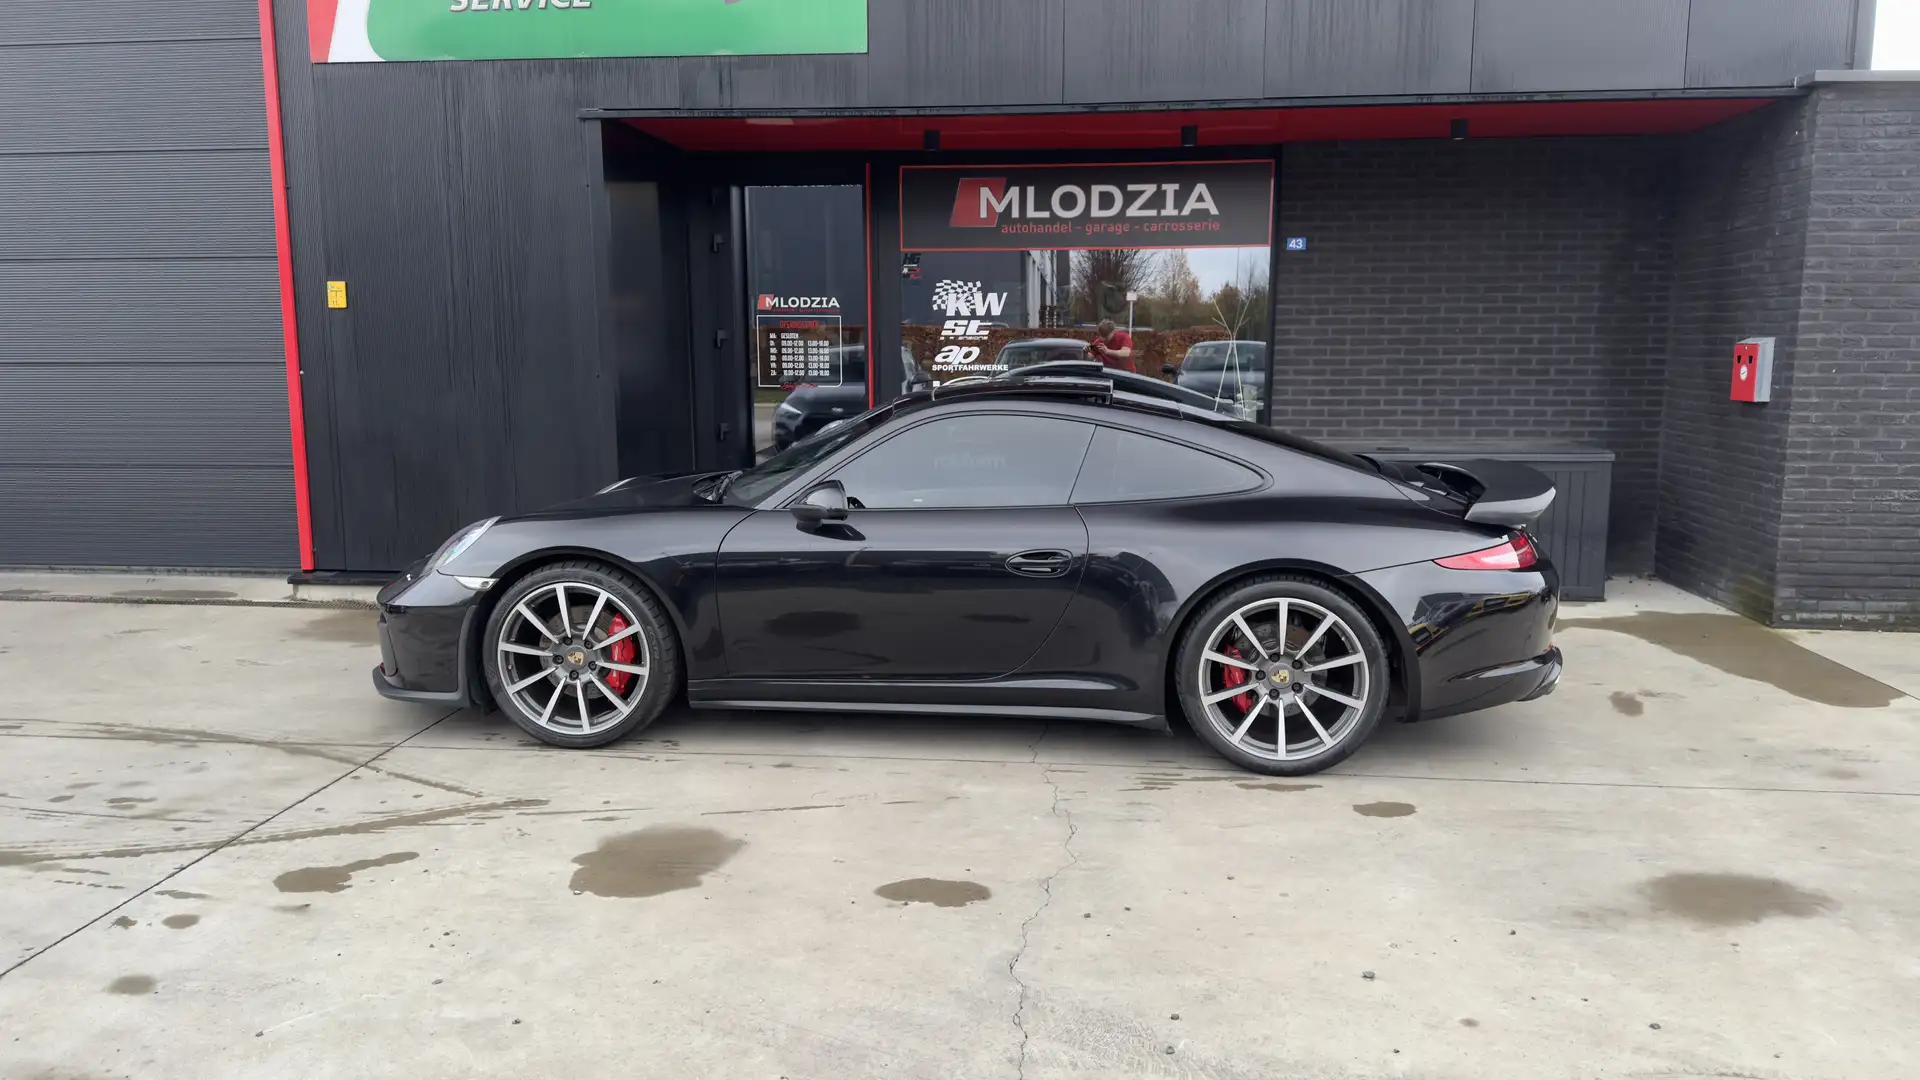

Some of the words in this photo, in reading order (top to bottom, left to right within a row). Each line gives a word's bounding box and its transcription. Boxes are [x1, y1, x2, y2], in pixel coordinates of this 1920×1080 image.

[979, 183, 1219, 219] MLODZIA
[1001, 220, 1073, 234] autohandel
[1085, 222, 1130, 236] garage
[1143, 219, 1221, 232] carrosserie
[1289, 238, 1303, 249] 43
[765, 296, 840, 308] MLODZIA
[945, 292, 1008, 317] KW
[934, 345, 981, 365] ap
[932, 364, 1009, 372] SPORTFAHRWERKE
